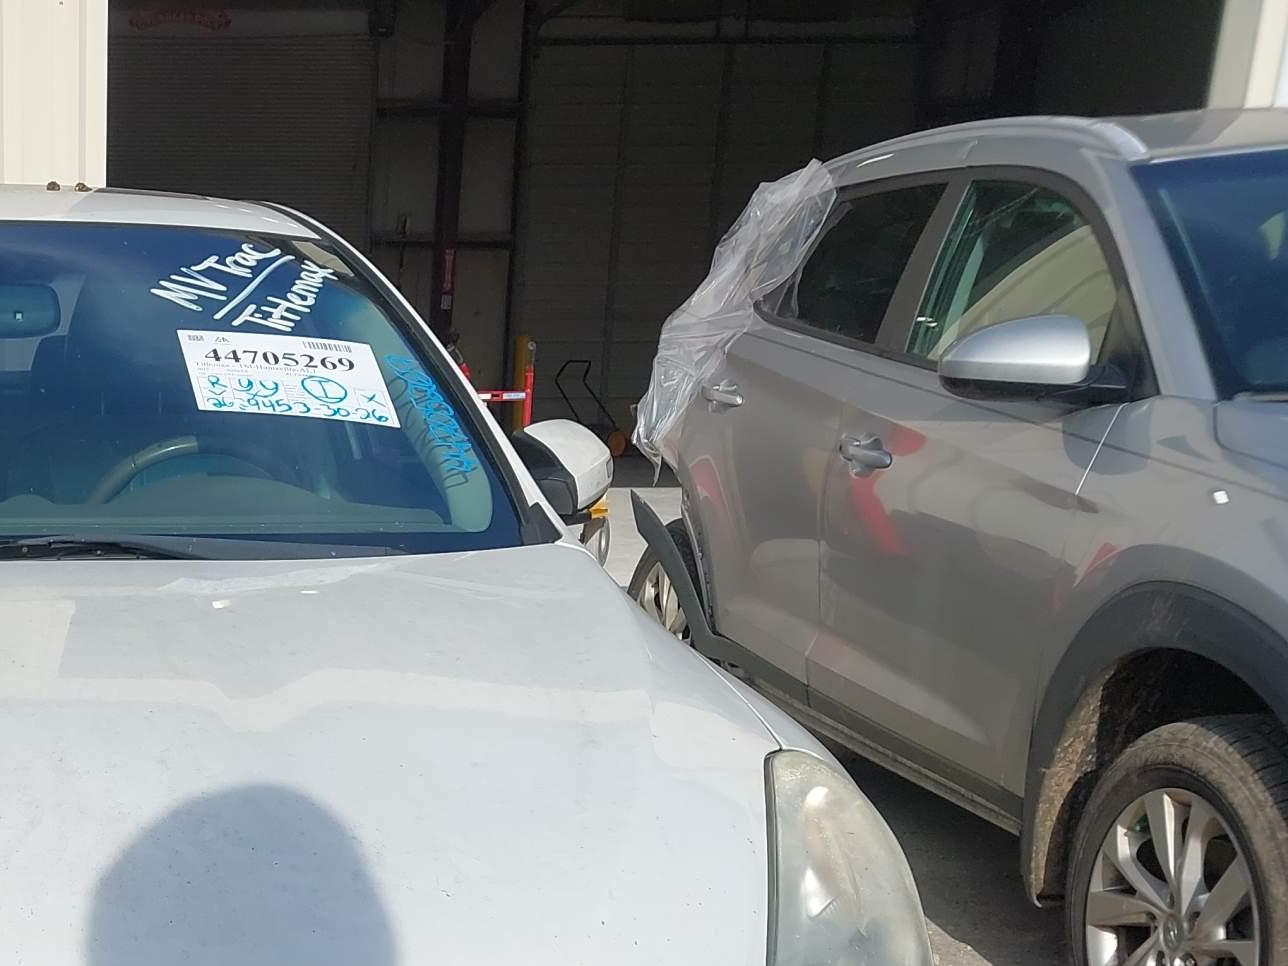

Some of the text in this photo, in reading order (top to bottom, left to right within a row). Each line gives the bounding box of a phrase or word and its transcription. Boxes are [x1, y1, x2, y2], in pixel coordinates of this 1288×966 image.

[150, 243, 282, 312] MV Trac
[204, 347, 356, 372] 44705269
